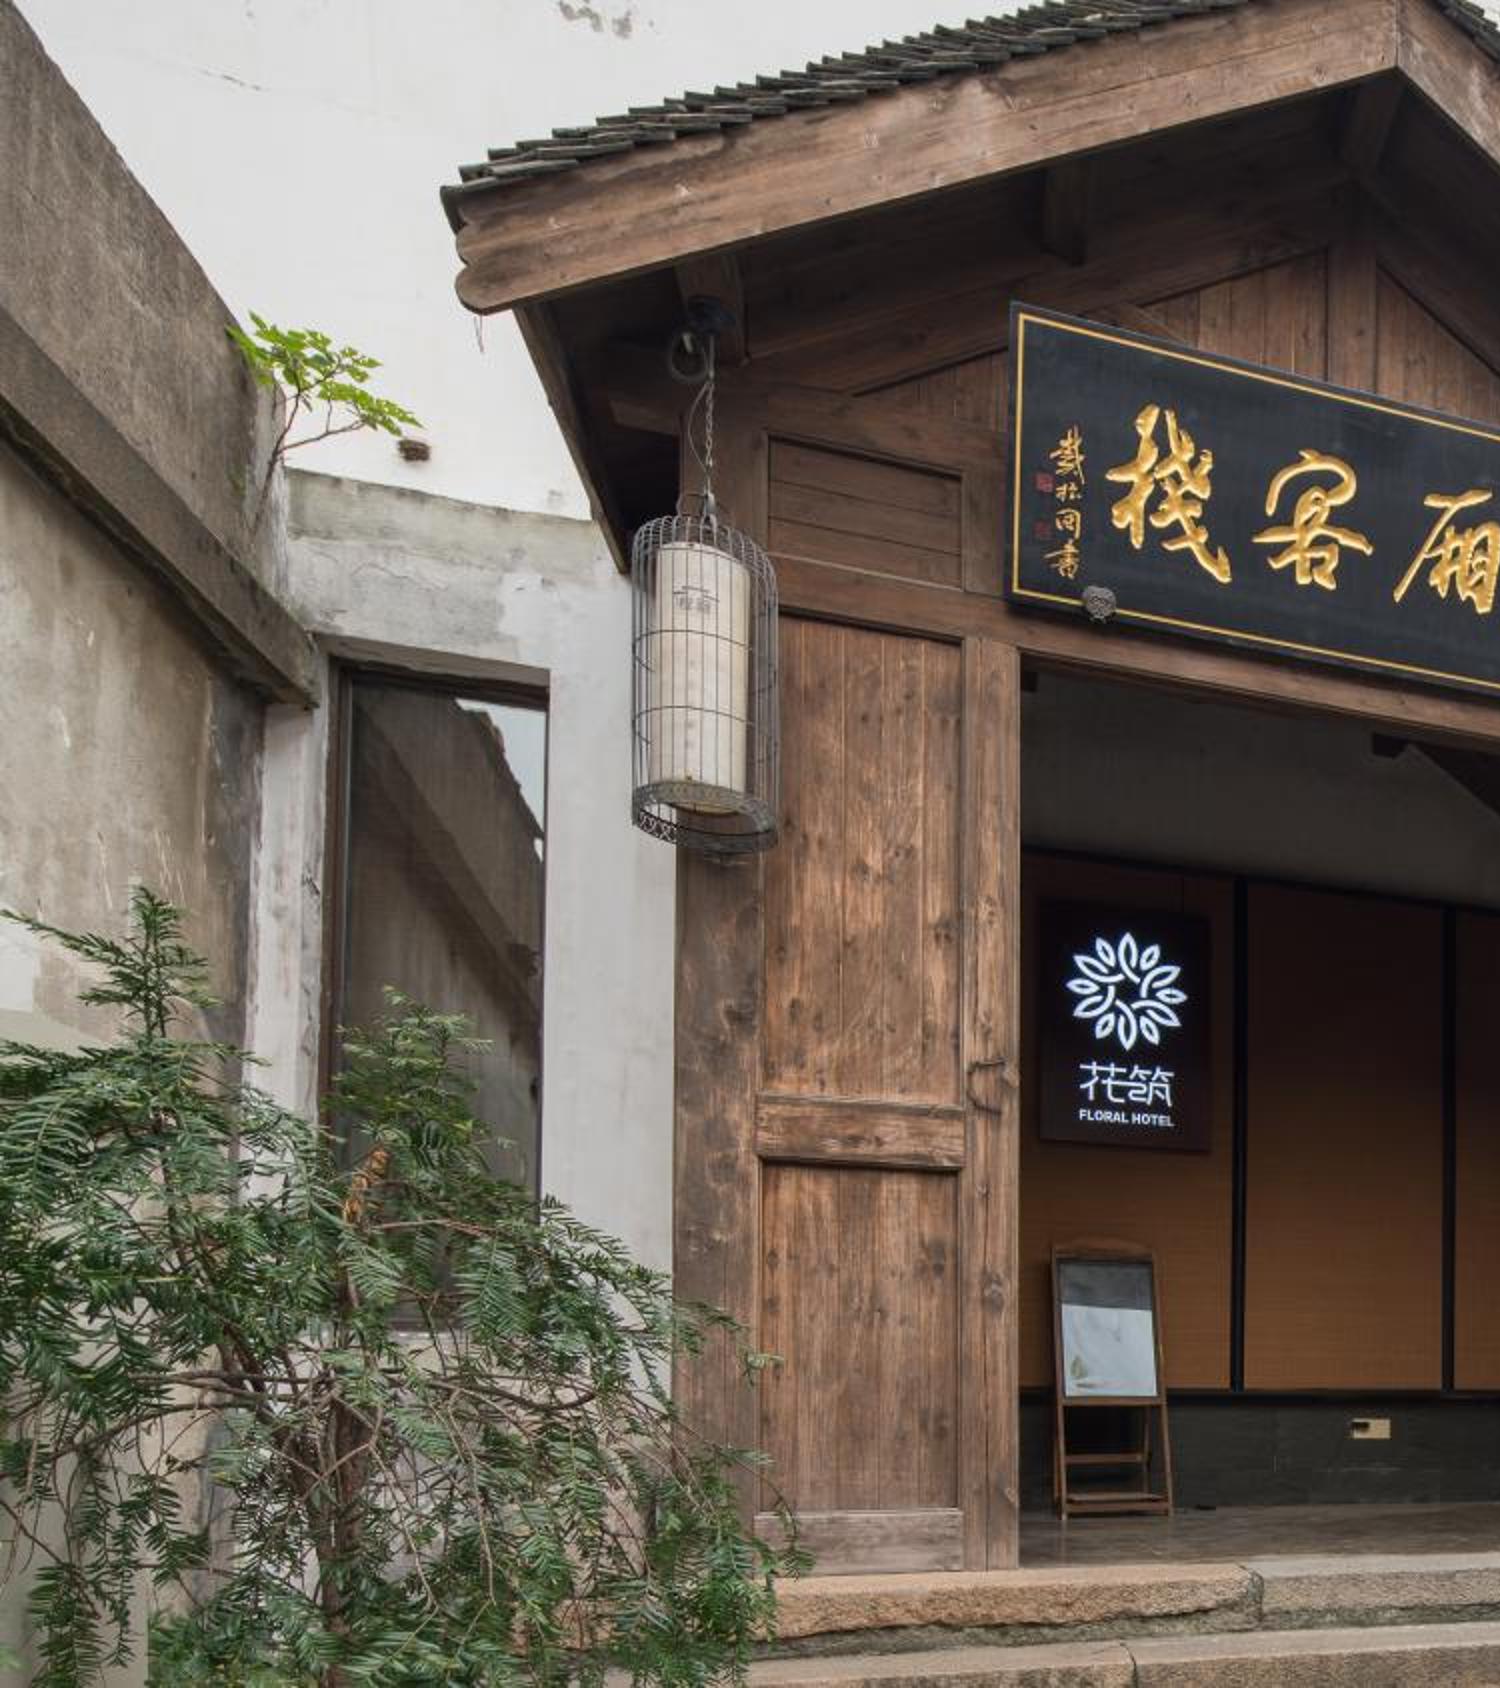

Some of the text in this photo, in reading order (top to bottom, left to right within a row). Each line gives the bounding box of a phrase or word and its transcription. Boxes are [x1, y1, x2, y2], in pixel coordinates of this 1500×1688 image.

[1080, 1061, 1175, 1108] 花筑
[1079, 1108, 1175, 1127] FLORAL HOTEL
